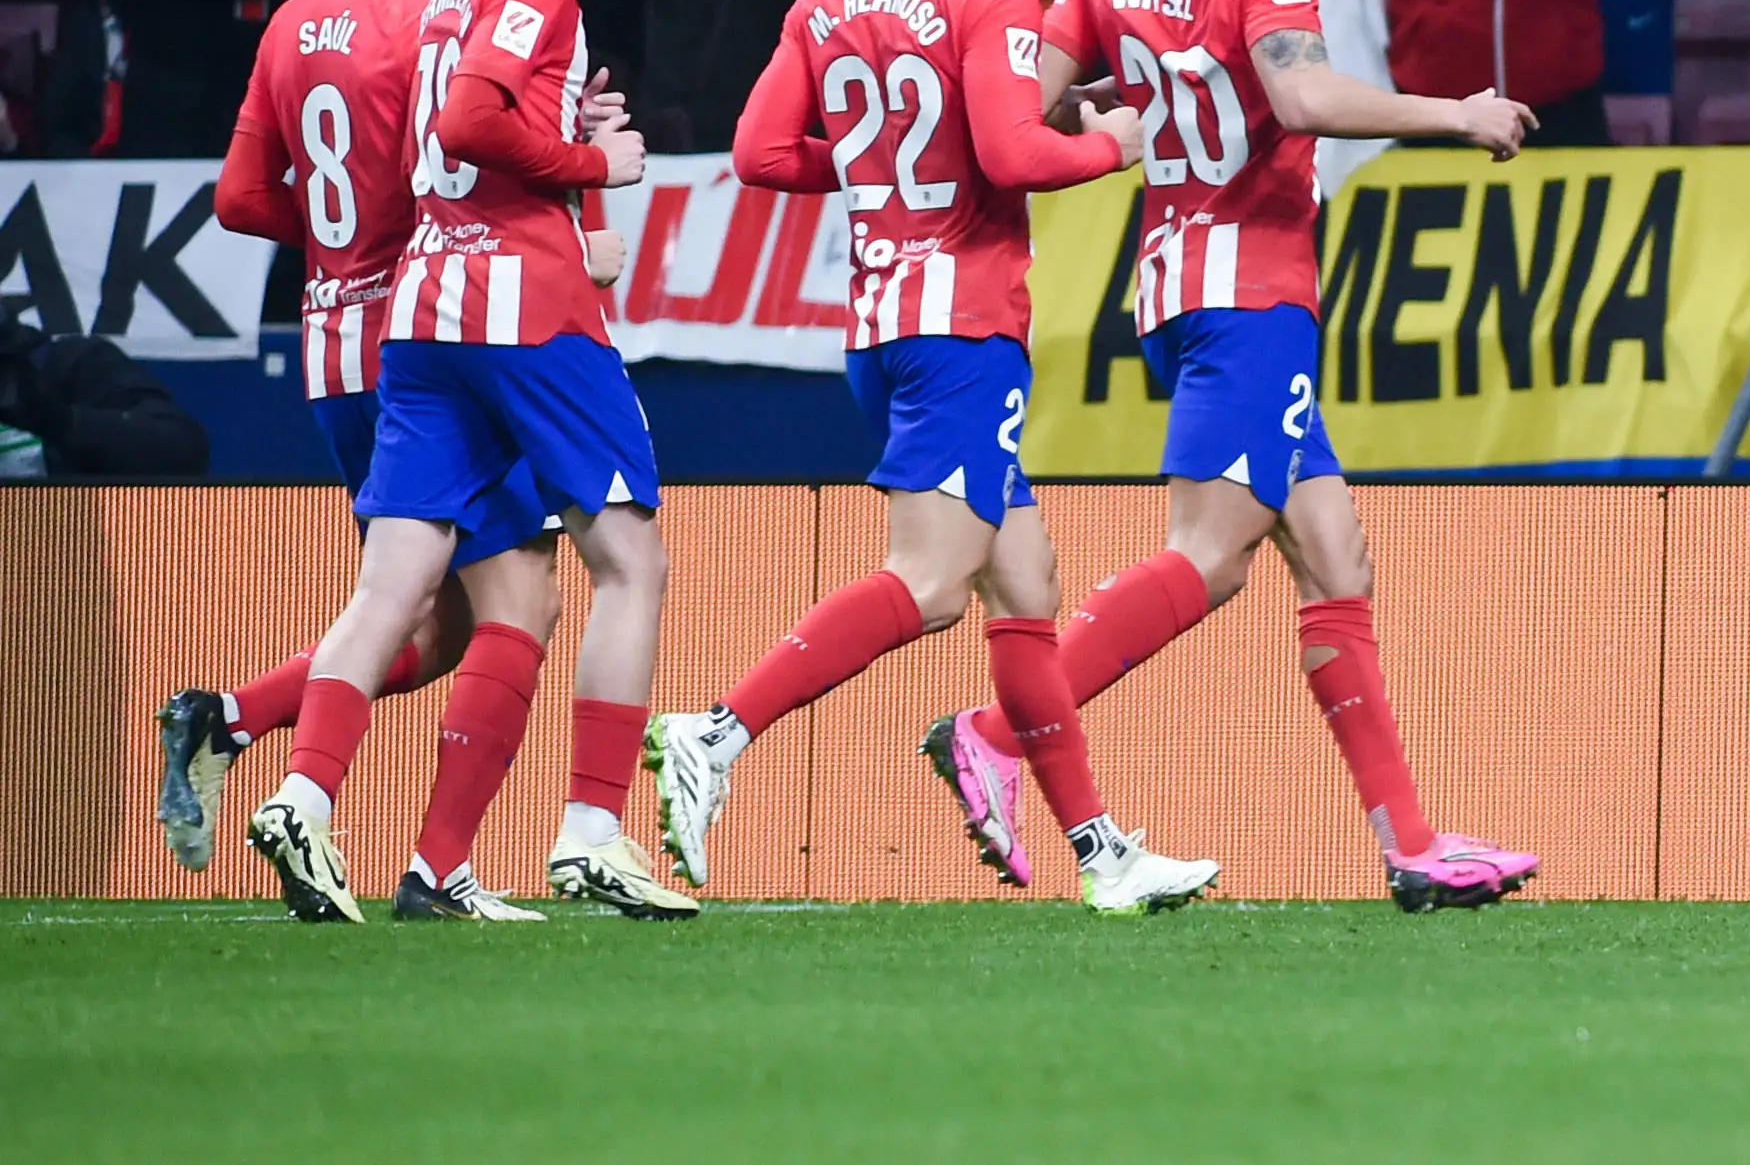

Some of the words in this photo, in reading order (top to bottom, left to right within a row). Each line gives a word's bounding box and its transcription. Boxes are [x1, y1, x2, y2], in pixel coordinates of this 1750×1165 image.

[299, 9, 358, 56] SAÚL
[807, 5, 841, 47] M.
[301, 82, 358, 249] 8
[822, 52, 958, 212] 22
[1119, 34, 1250, 187] 20
[582, 168, 848, 328] ÚL
[853, 221, 897, 268] ia
[1083, 168, 1684, 405] AMENIA
